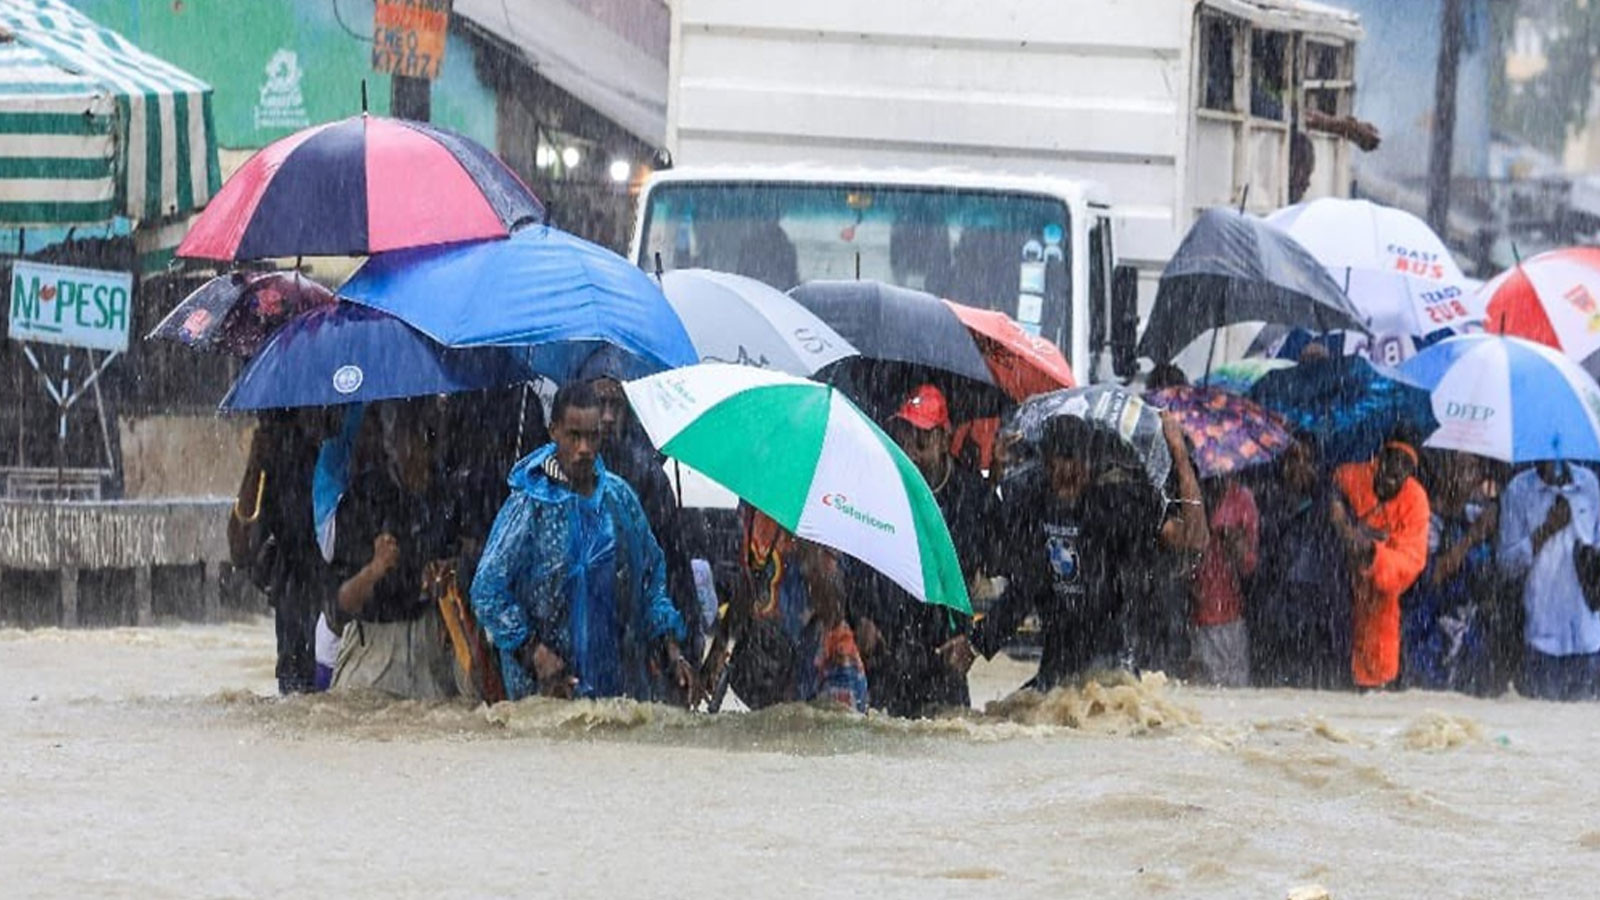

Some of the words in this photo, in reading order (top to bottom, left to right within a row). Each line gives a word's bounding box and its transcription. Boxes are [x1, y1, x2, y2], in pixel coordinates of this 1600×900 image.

[1387, 243, 1438, 261] COAST
[1396, 257, 1444, 279] BUS
[834, 496, 896, 535] Safaricom
